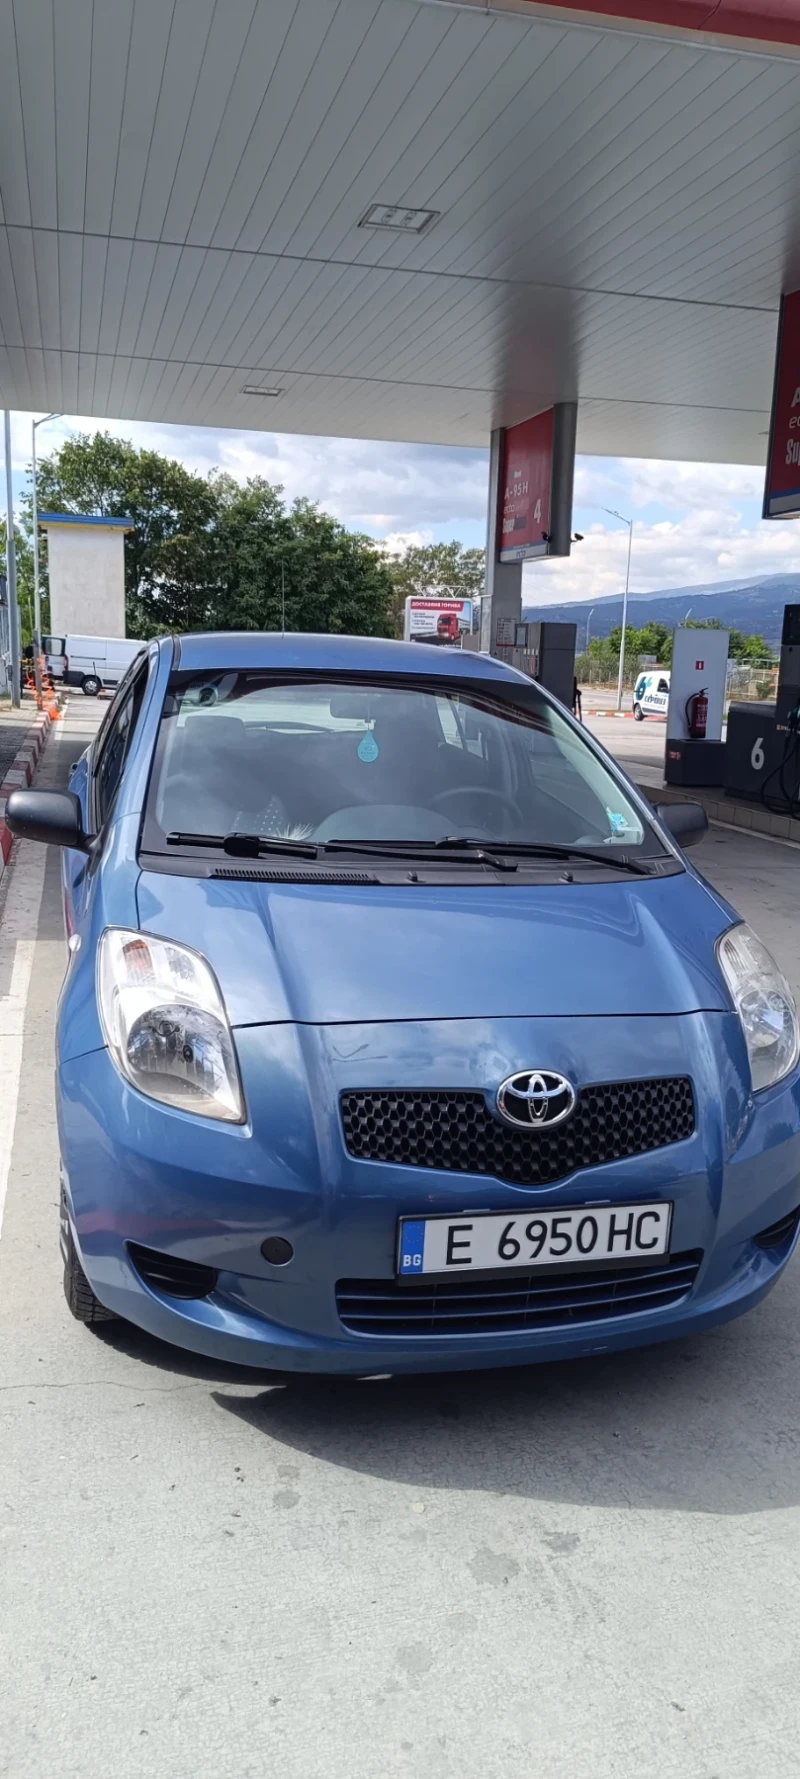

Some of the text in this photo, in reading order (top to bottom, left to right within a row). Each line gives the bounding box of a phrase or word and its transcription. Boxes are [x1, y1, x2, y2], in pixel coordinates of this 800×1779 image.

[533, 498, 542, 524] 4
[751, 737, 765, 770] 6
[446, 1211, 661, 1266] E 6950 HC
[403, 1254, 422, 1267] BG
